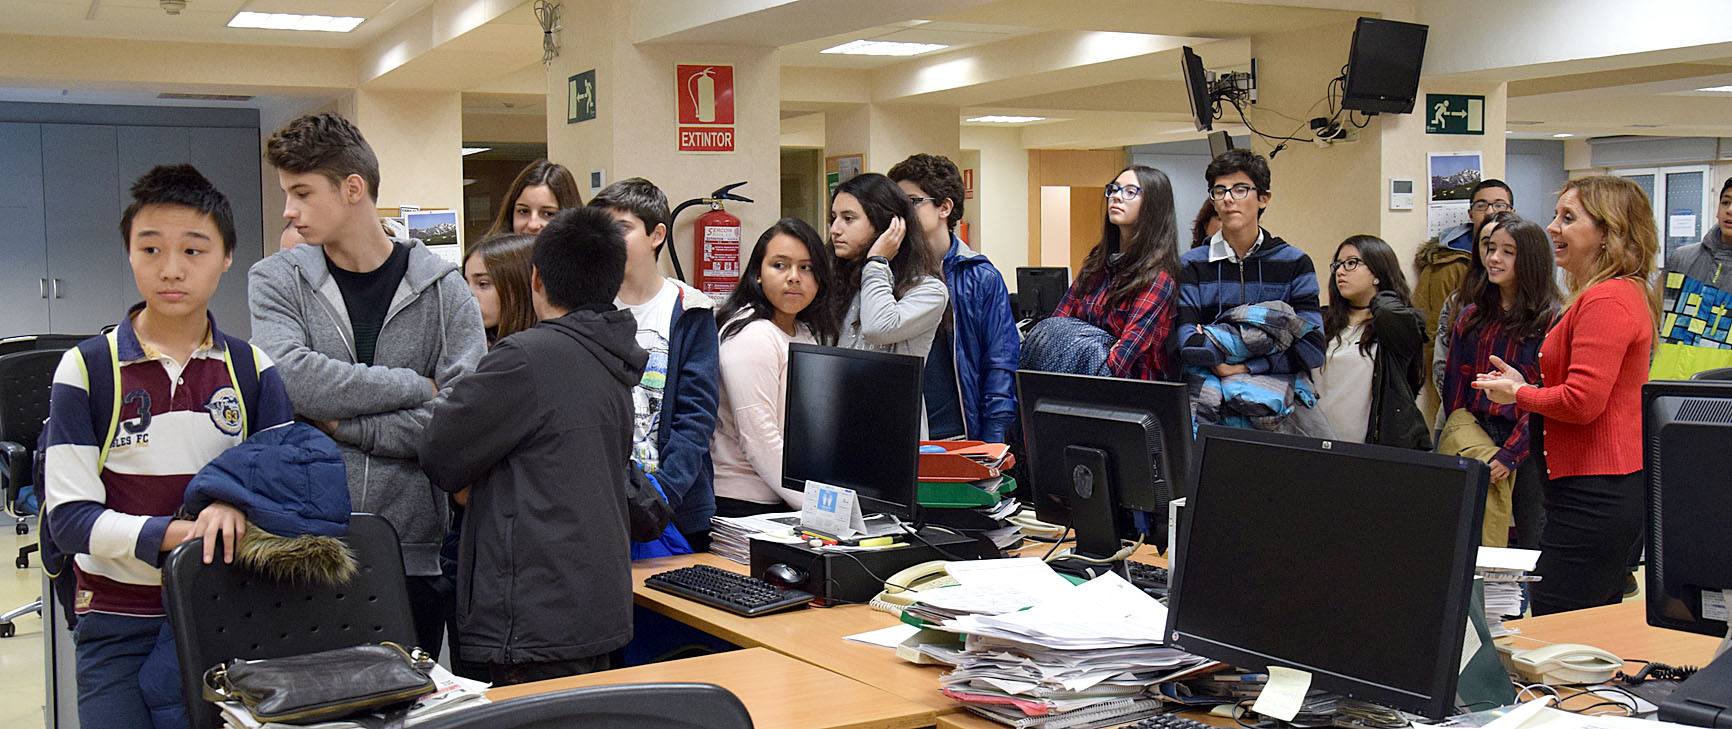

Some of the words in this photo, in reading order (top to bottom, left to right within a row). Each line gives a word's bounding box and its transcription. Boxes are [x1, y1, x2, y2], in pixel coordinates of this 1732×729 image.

[682, 131, 732, 147] EXTINTOR
[117, 388, 152, 435] 3
[136, 433, 149, 443] FC
